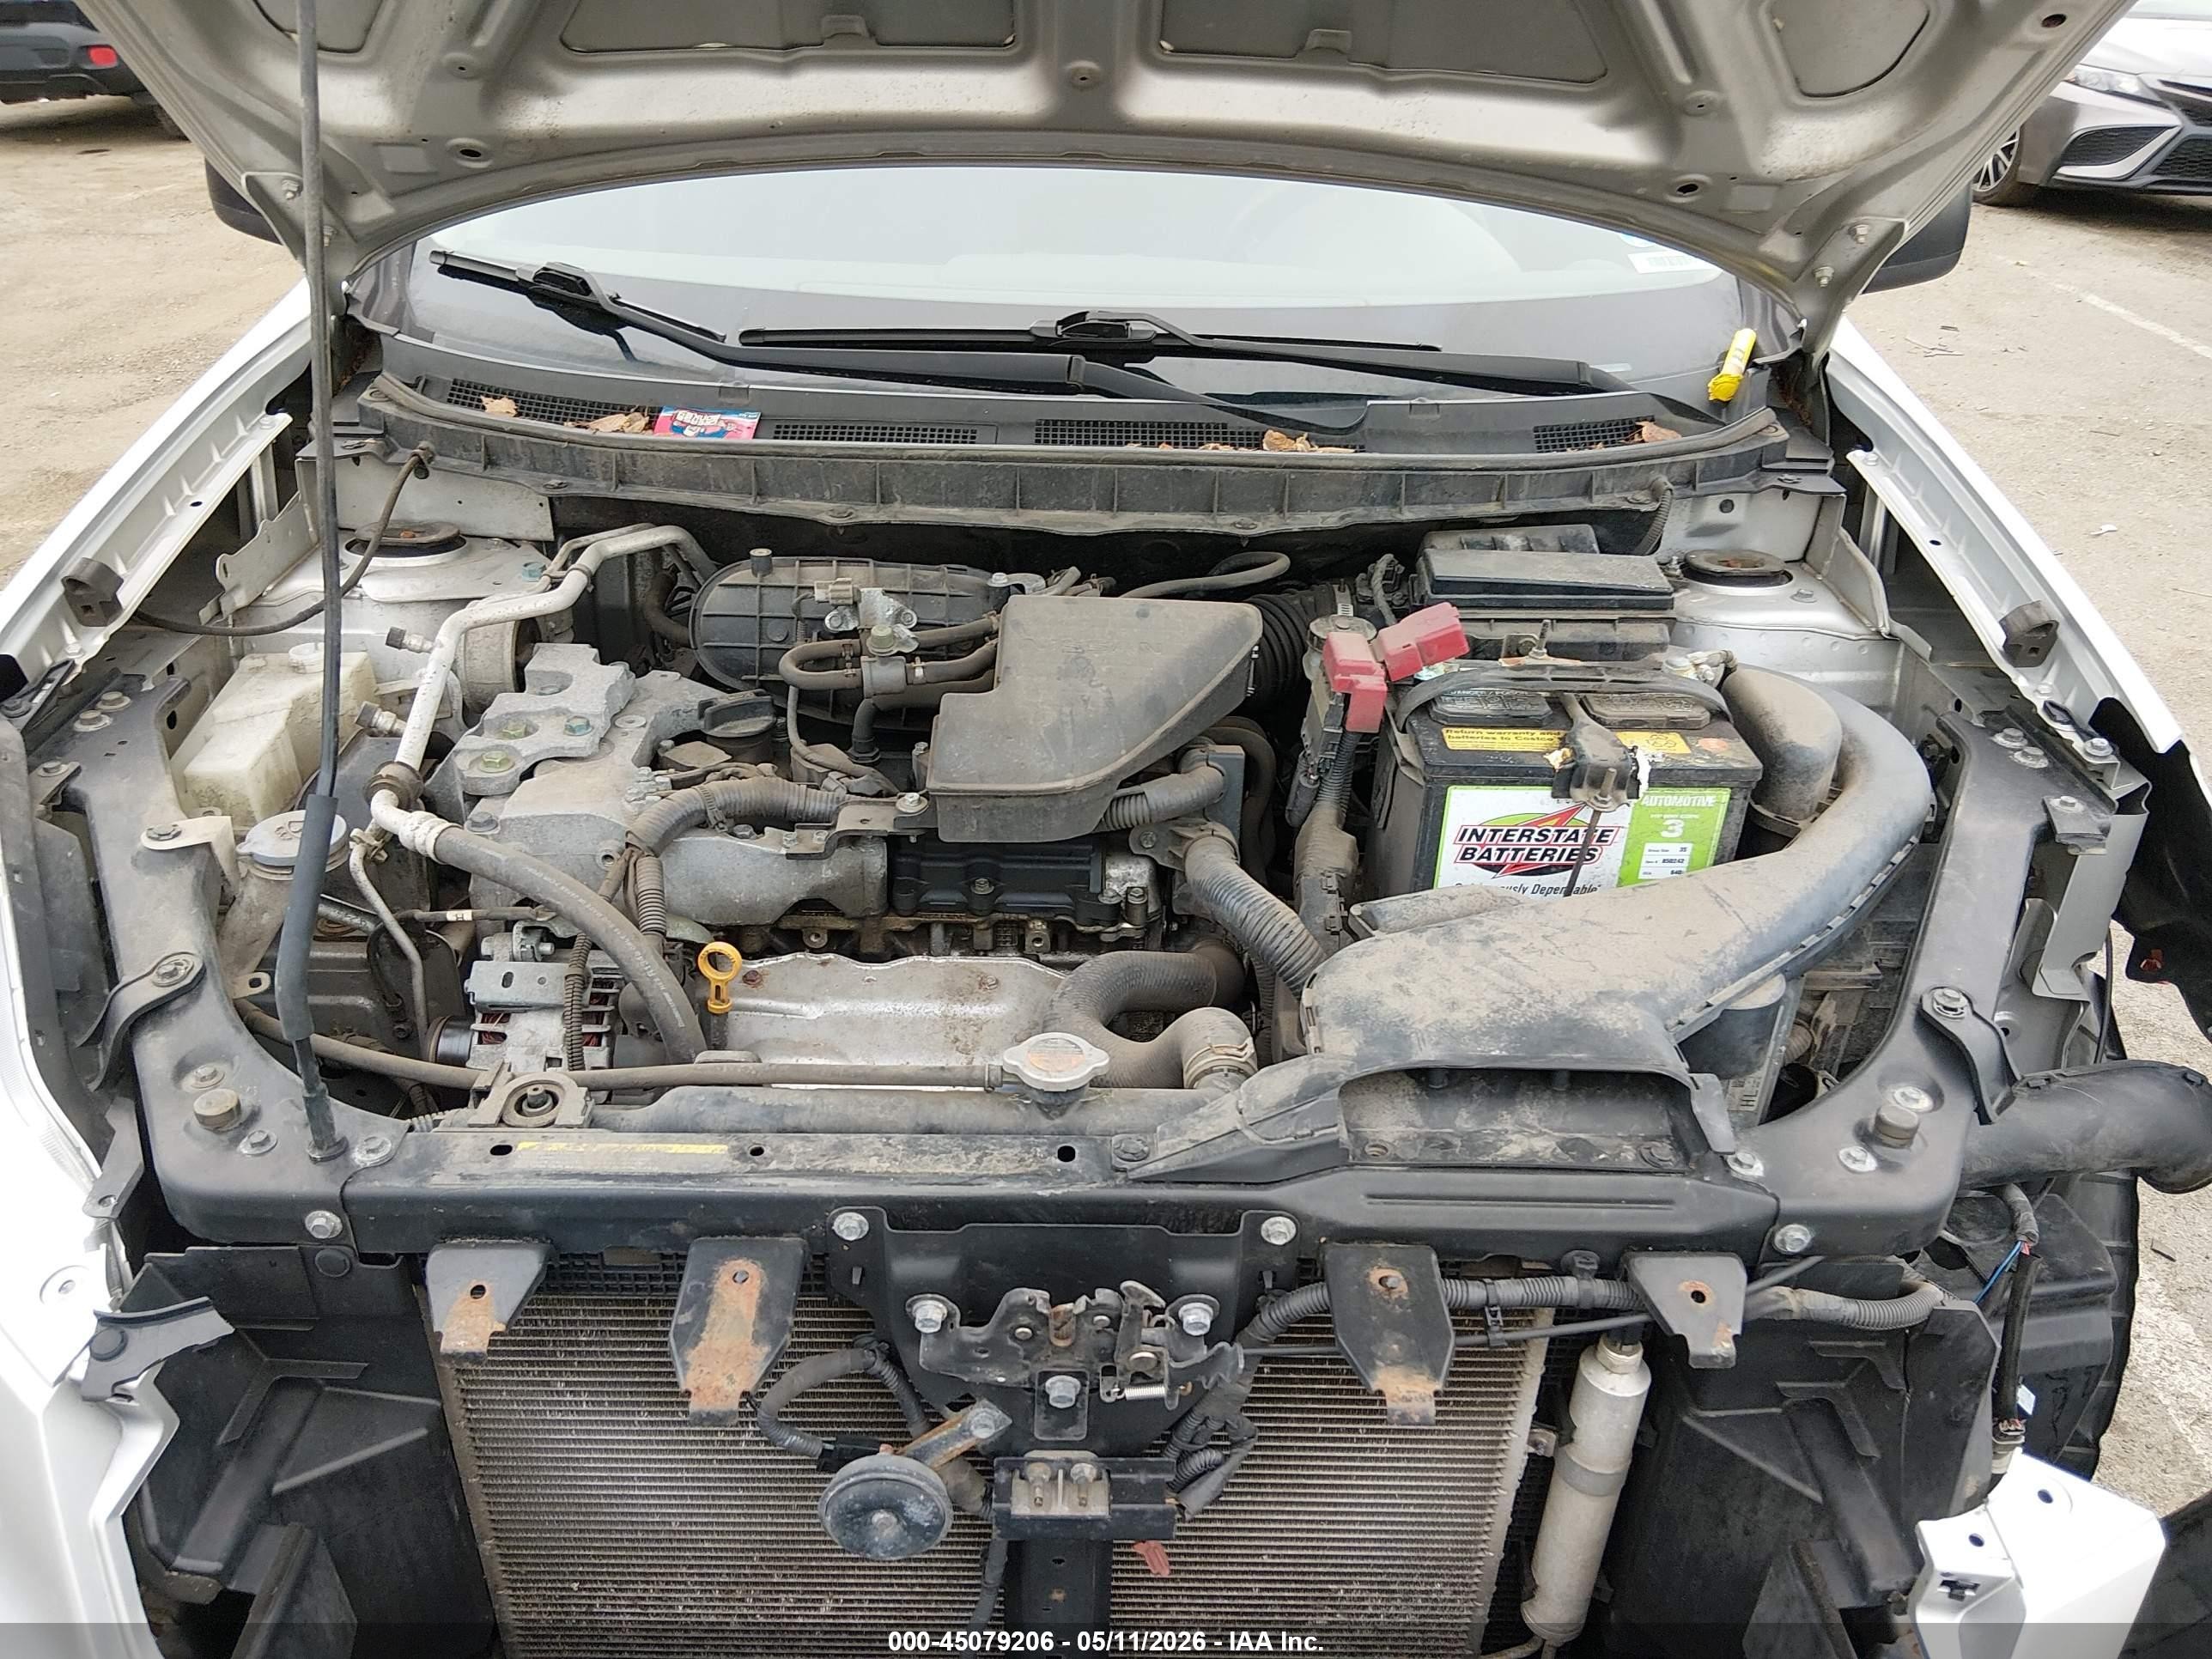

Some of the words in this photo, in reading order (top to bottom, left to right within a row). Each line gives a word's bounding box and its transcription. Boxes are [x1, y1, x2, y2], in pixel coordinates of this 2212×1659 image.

[1641, 795, 1716, 807] AUTOMOTIVE
[1660, 818, 1685, 838] 3
[1459, 848, 1599, 862] BATTERIES
